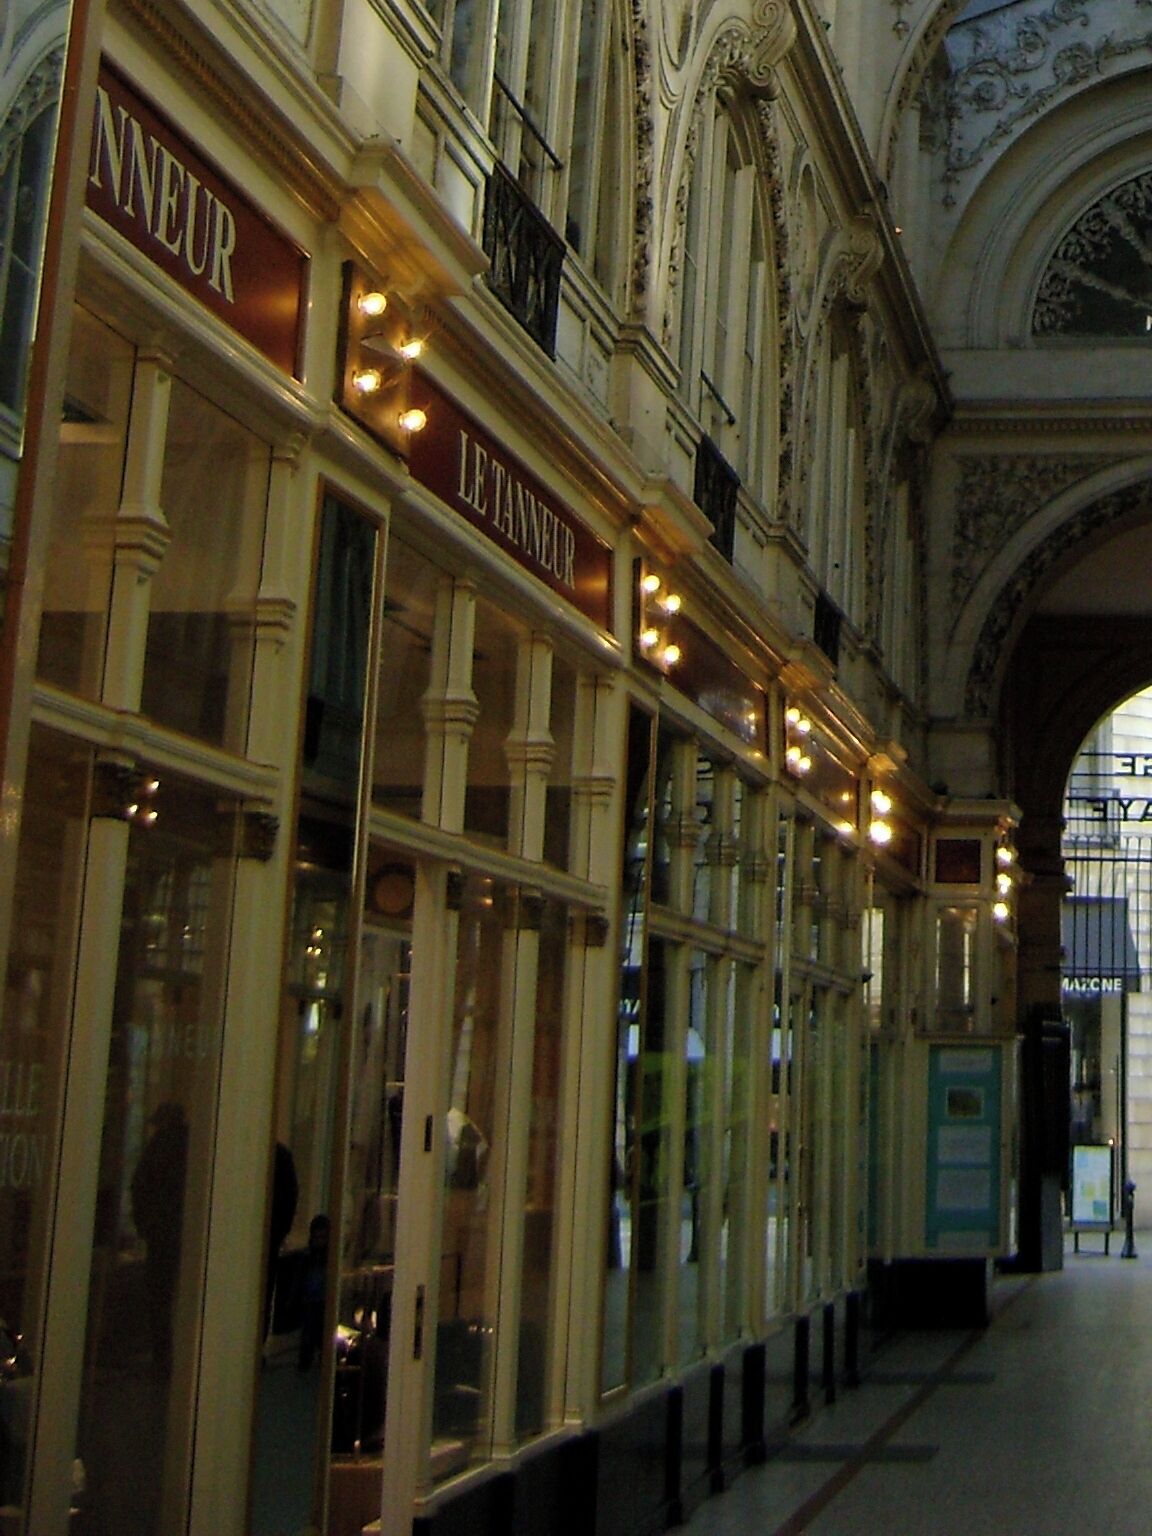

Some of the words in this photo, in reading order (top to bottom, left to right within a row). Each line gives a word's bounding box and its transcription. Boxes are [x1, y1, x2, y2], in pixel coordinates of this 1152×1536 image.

[89, 85, 236, 304] NNEUR
[458, 430, 487, 516] LE
[492, 459, 575, 590] TANNEUR
